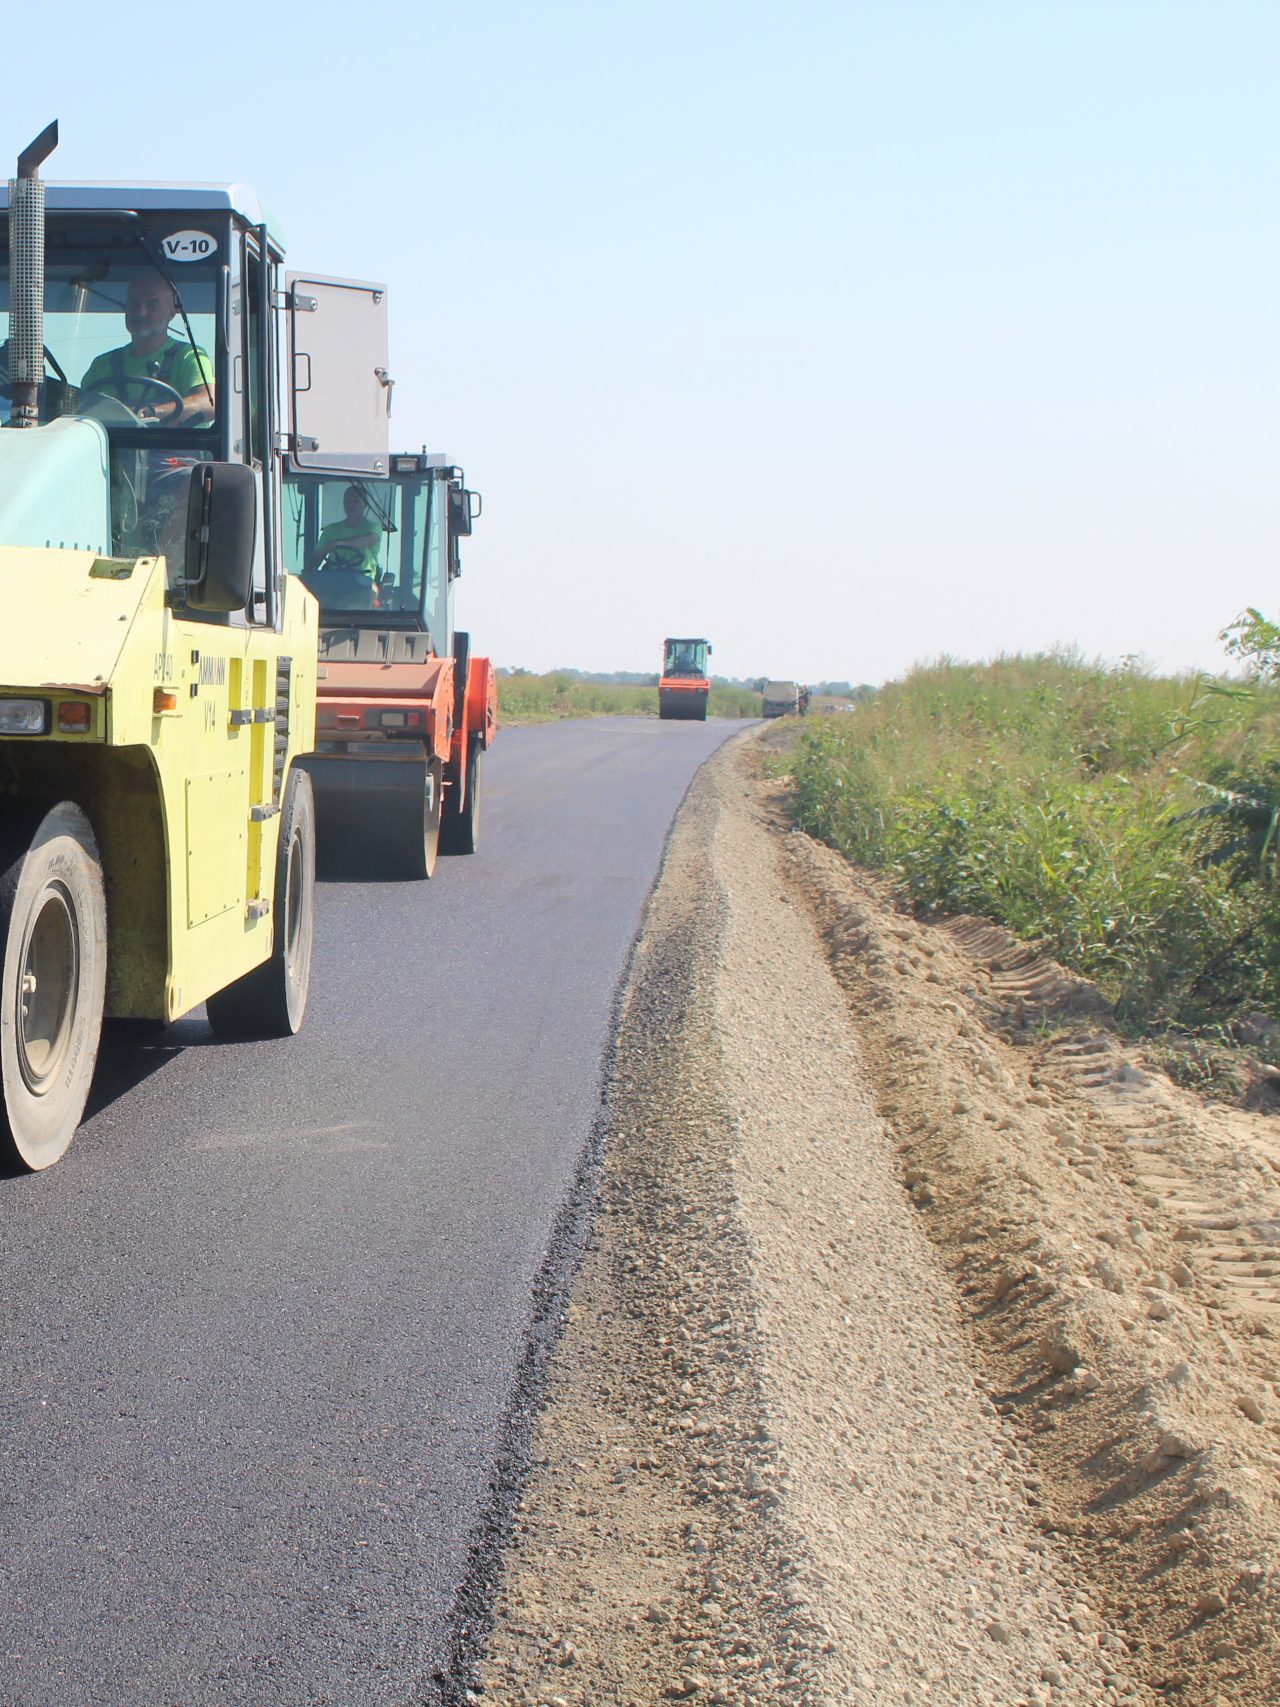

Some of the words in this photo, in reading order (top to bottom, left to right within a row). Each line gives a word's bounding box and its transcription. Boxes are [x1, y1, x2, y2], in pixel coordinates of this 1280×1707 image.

[166, 240, 209, 254] V-10
[198, 656, 225, 685] AMMANN
[204, 700, 216, 733] V14
